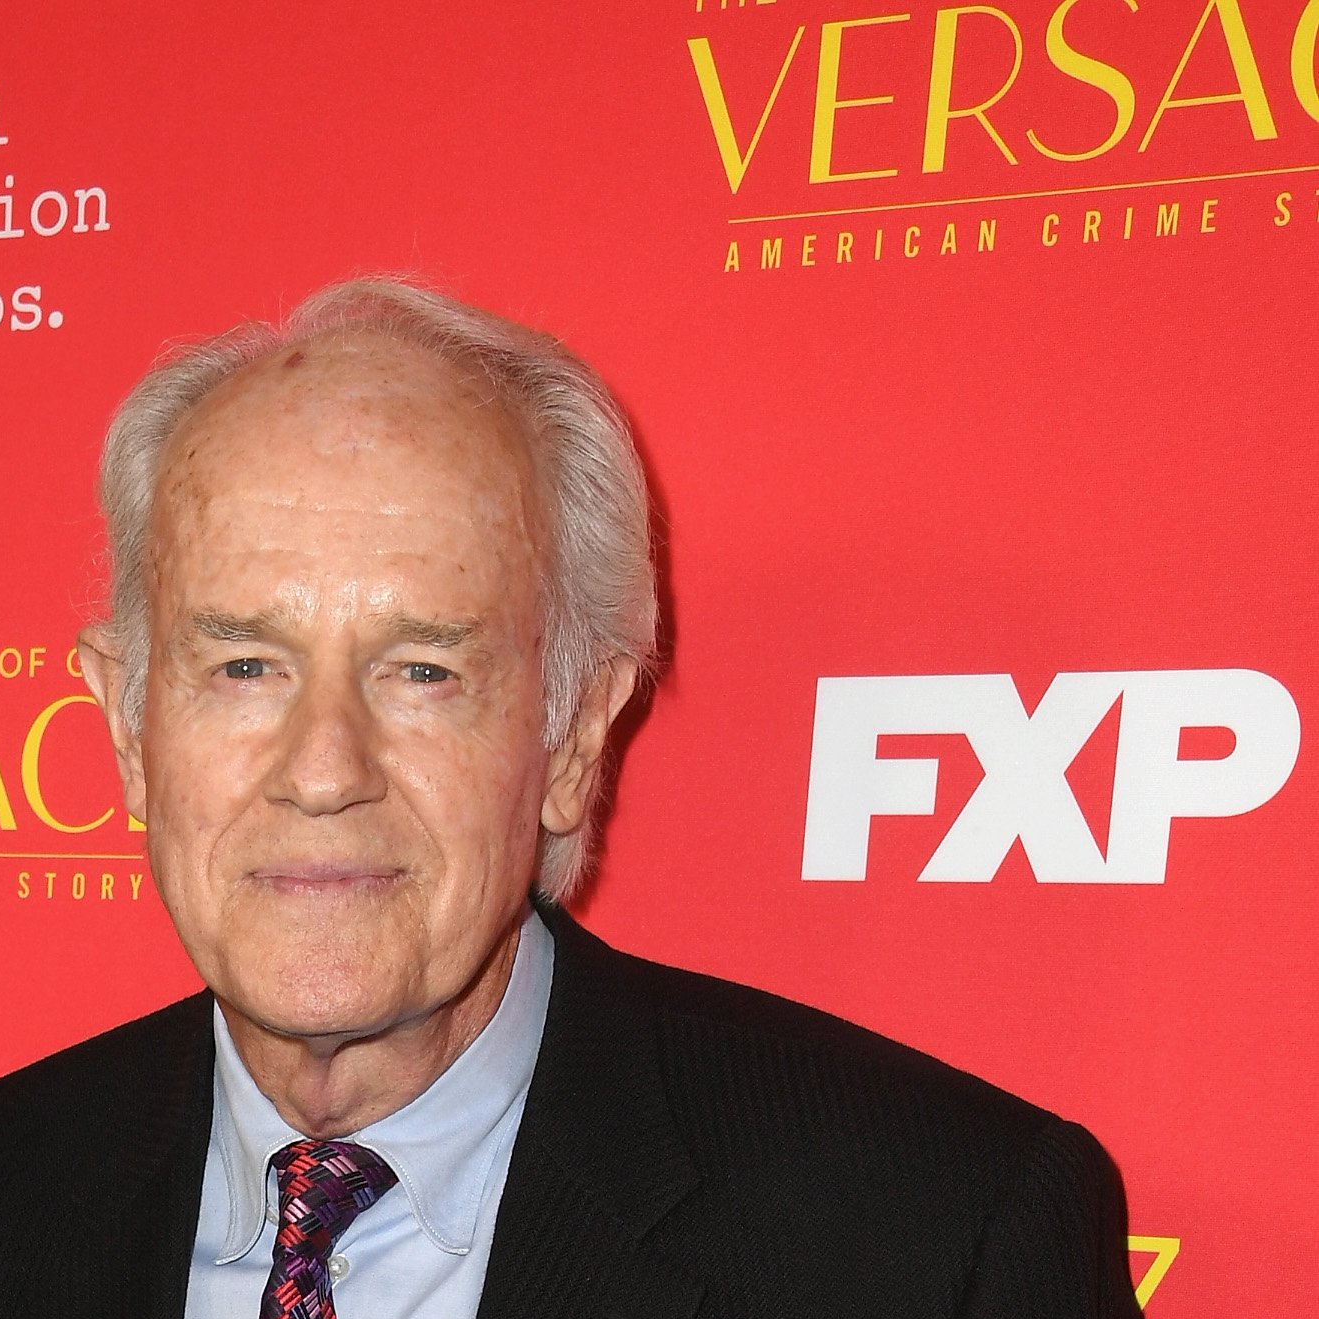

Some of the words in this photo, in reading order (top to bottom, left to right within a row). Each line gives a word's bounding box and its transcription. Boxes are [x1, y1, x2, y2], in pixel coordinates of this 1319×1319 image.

[723, 219, 997, 273] AMERICAN
[1041, 199, 1219, 247] CRIME
[800, 667, 1302, 884] FXP
[17, 871, 144, 901] STORY
